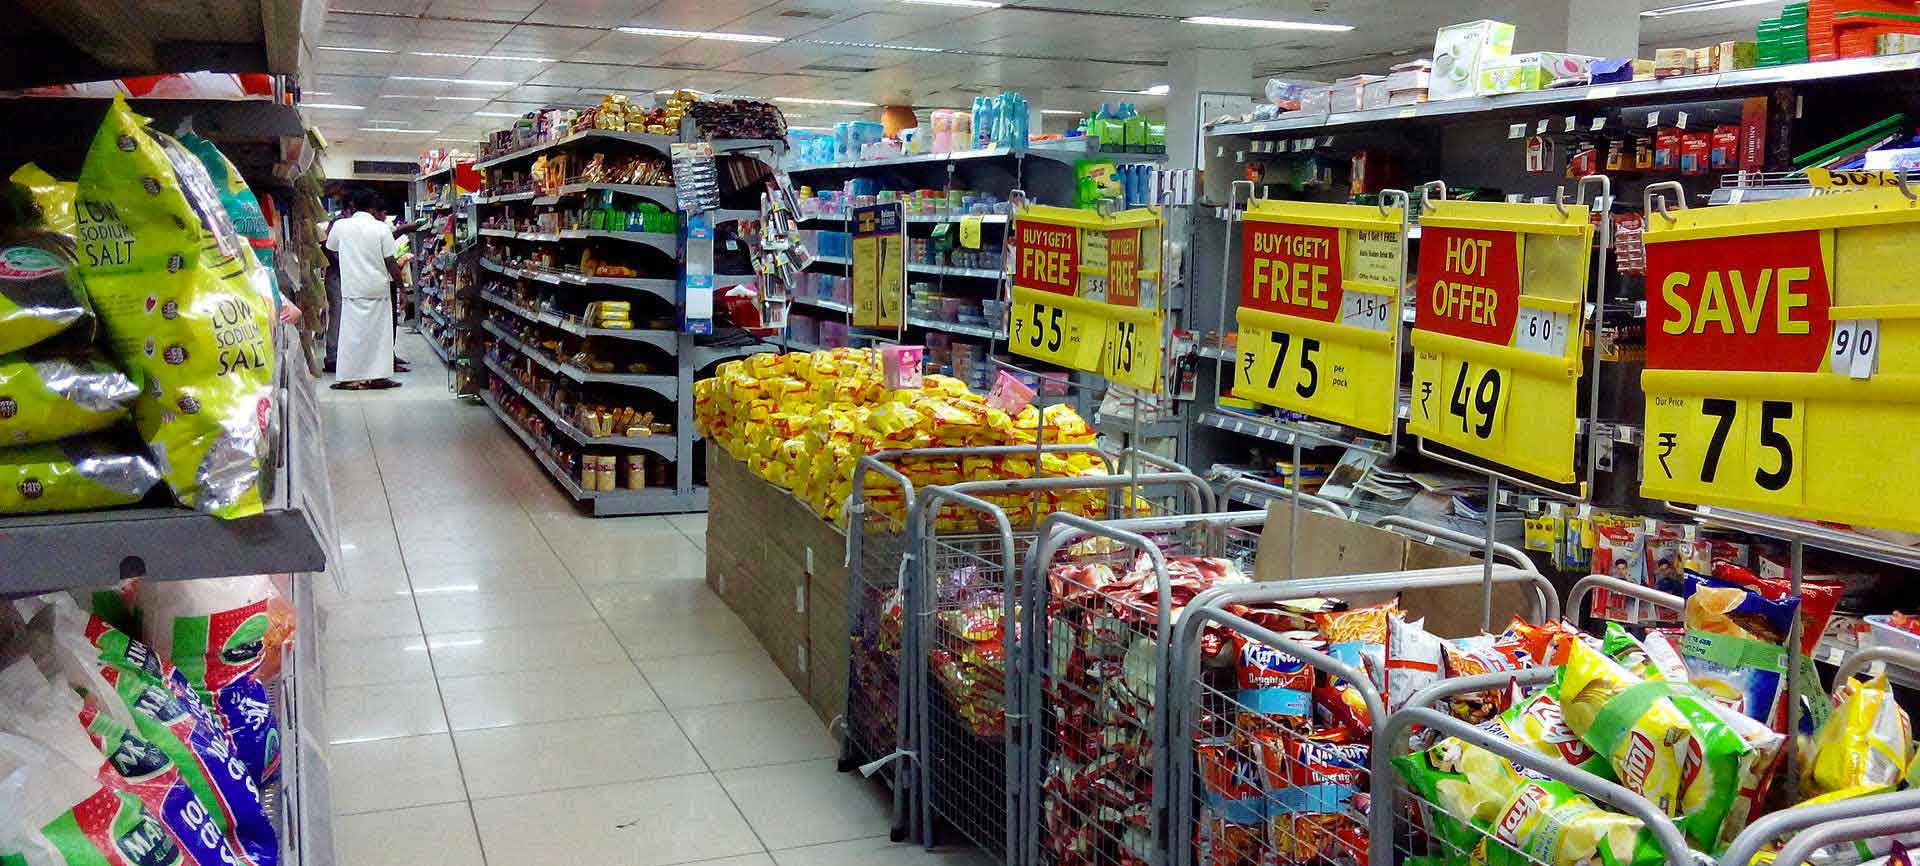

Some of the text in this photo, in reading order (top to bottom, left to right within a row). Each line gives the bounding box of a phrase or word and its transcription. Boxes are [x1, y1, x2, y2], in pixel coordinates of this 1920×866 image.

[85, 240, 135, 267] SALT
[1022, 248, 1072, 286] FREE
[1446, 237, 1492, 277] HOT
[1111, 260, 1135, 297] FREE
[1253, 257, 1329, 310] FREE
[1356, 298, 1387, 321] 150
[1432, 279, 1498, 328] OFFER
[1662, 266, 1810, 336] SAVE
[1030, 303, 1063, 352] 55
[1117, 320, 1134, 373] 75
[1529, 316, 1551, 341] 60
[1834, 329, 1872, 356] 90
[217, 340, 266, 377] SALT
[1267, 331, 1320, 399] 75
[1333, 365, 1345, 374] per
[1332, 378, 1348, 388] pack
[1450, 361, 1501, 439] 49
[1655, 397, 1684, 407] Our Price
[1700, 397, 1794, 491] 75
